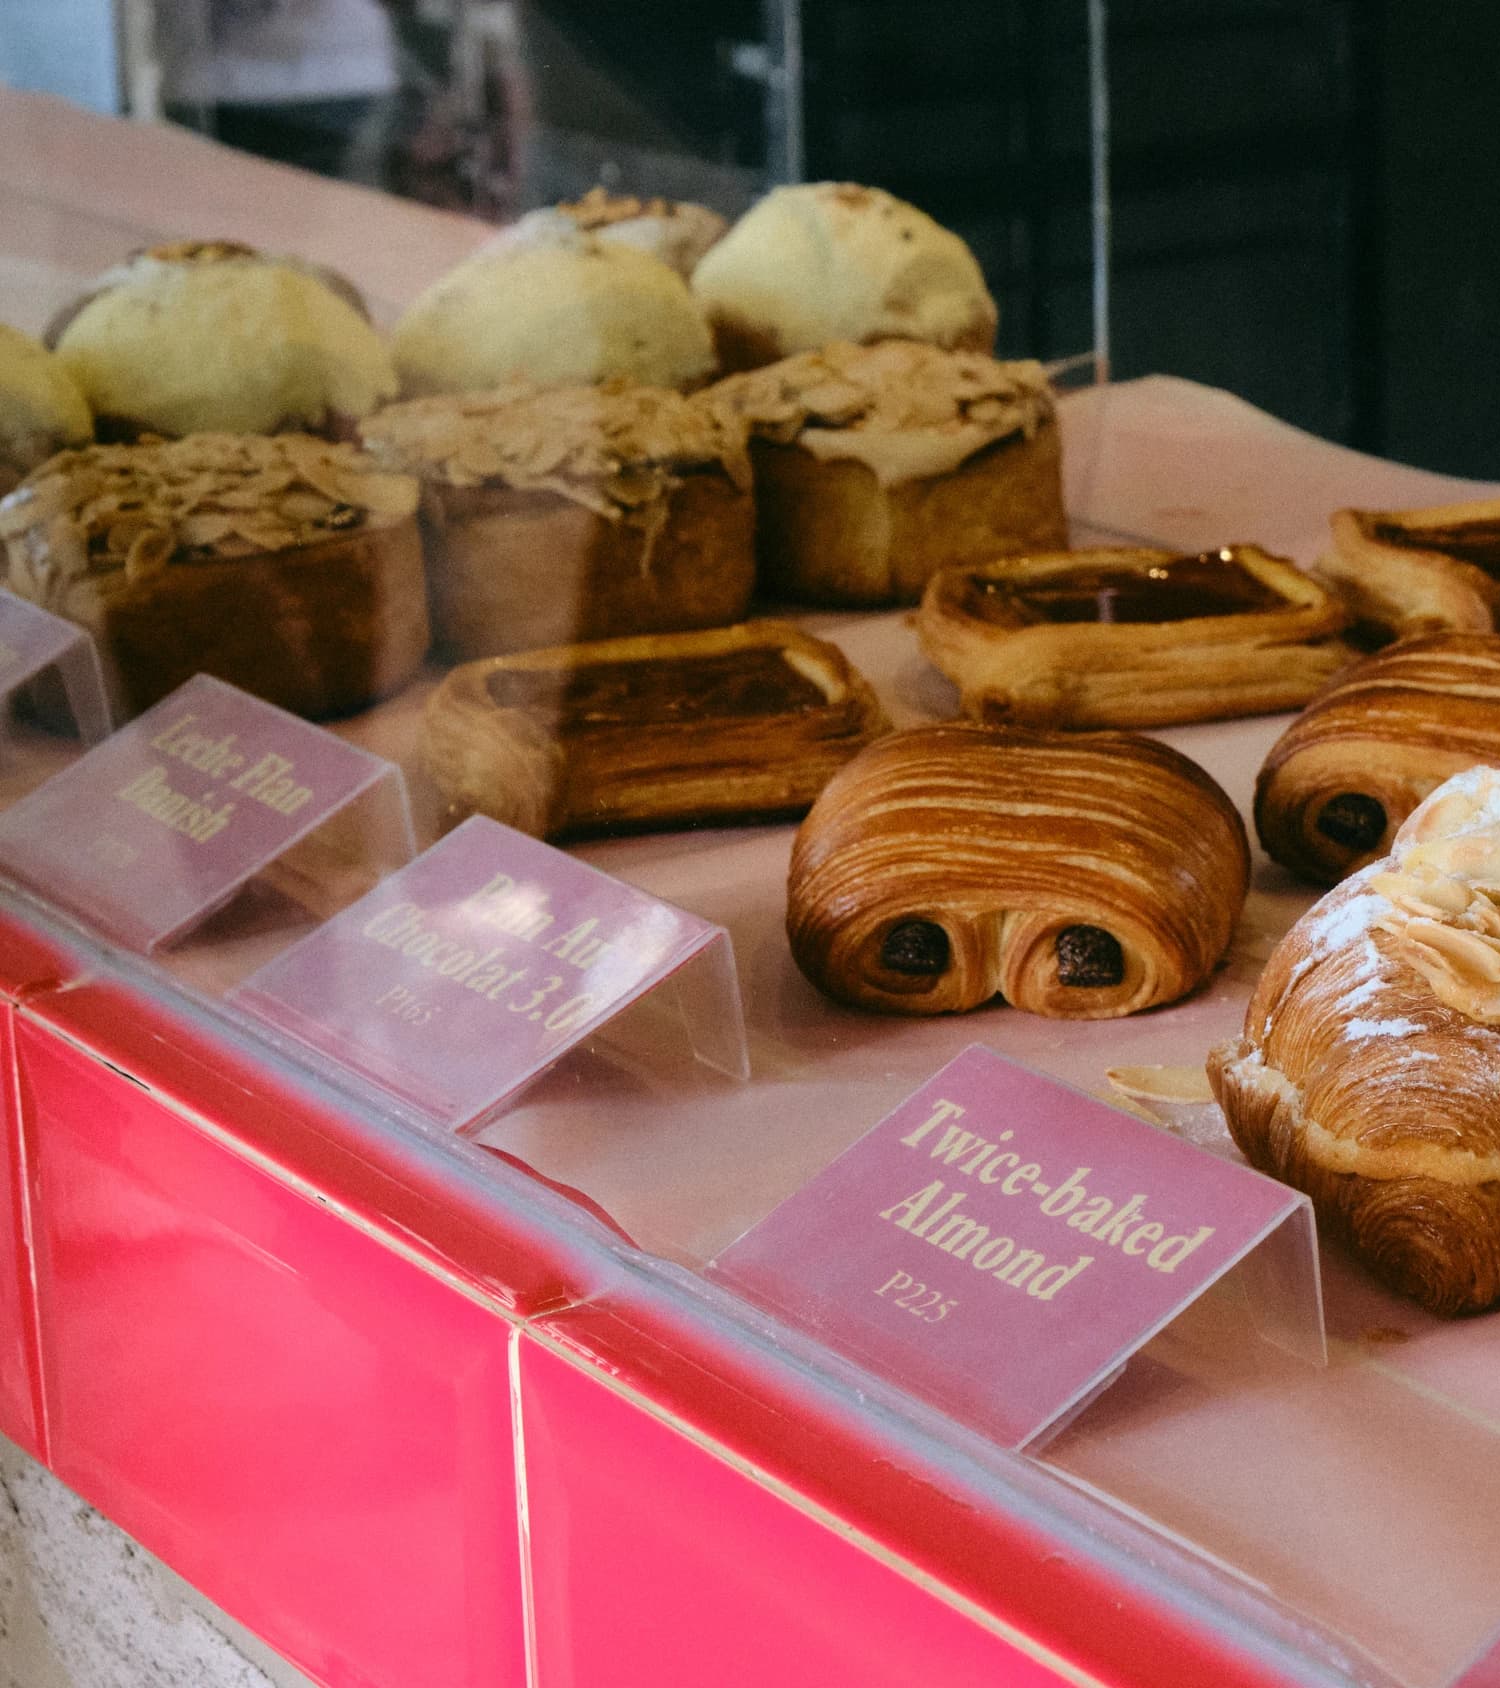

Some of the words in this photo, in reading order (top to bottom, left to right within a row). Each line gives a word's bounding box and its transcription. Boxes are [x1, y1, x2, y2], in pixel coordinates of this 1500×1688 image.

[229, 752, 313, 816] Flan
[362, 902, 529, 1001] Chocolat
[506, 975, 593, 1031] 3.0
[878, 1180, 1095, 1302] Almond
[899, 1099, 1216, 1275] Twice-baked
[873, 1269, 960, 1325] P225
